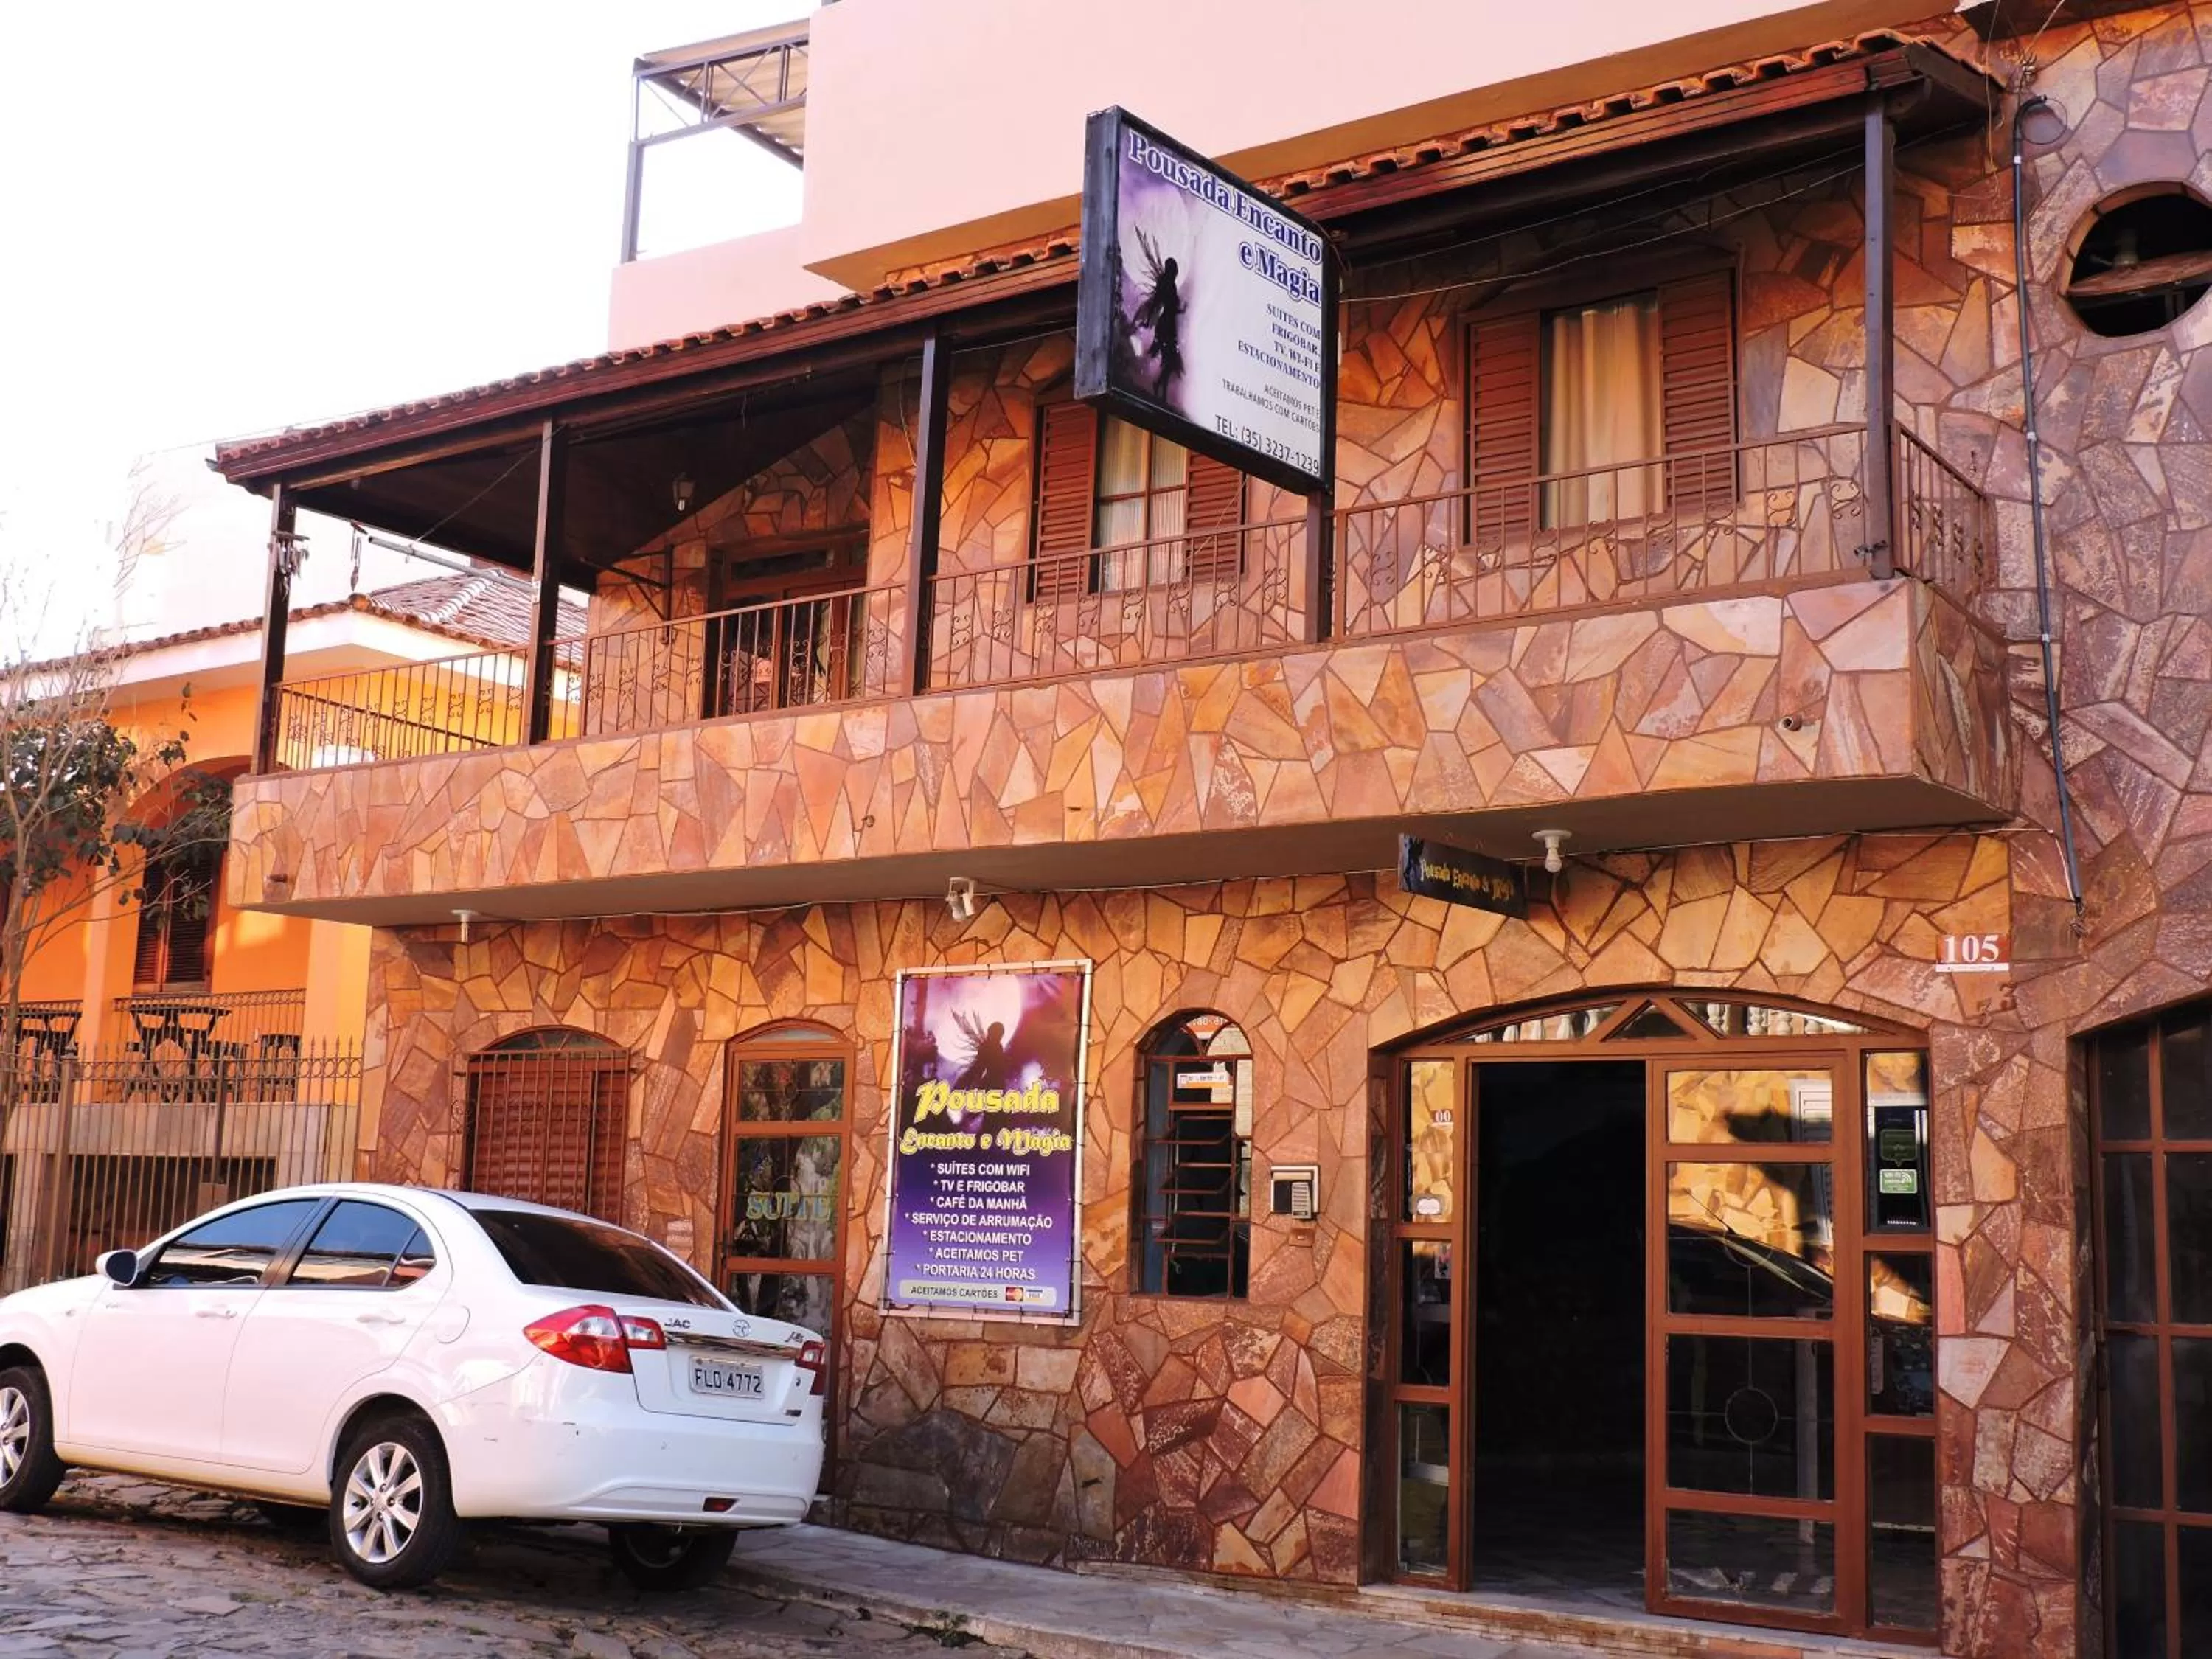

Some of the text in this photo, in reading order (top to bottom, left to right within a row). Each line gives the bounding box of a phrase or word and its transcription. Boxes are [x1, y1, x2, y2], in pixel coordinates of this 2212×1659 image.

[1128, 129, 1321, 263] Pousada Encanto
[1239, 244, 1321, 305] e Magia
[1267, 303, 1321, 340] SUITES COM
[1239, 339, 1320, 390] ESTACIONAMENTO
[1222, 378, 1273, 411] TRABALHAMOS
[1275, 403, 1290, 418] COM
[1264, 383, 1302, 410] ACEITAMOS
[1303, 403, 1315, 416] PET
[1215, 414, 1319, 474] TEL: (35) 3237-1239
[1944, 934, 1999, 962] 105
[914, 1079, 1060, 1124] Pousada
[899, 1127, 1073, 1157] Encanto e Magia
[937, 1161, 1030, 1176] SUÍTES COM WIFI
[940, 1179, 1025, 1193] TV E FRIGOBAR
[936, 1194, 1027, 1210] CAFÉ DA MANHÃ
[911, 1213, 1053, 1230] SERVIÇO DE ARRUMAÇÃO
[930, 1230, 1032, 1245] ESTACIONAMENTO
[935, 1248, 1023, 1262] ACEITAMOS PET
[922, 1264, 1036, 1280] PORTARIA 24 HORAS
[911, 1287, 957, 1297] ACEITAMOS
[664, 1318, 692, 1329] JAC
[695, 1368, 762, 1393] FLO 4772
